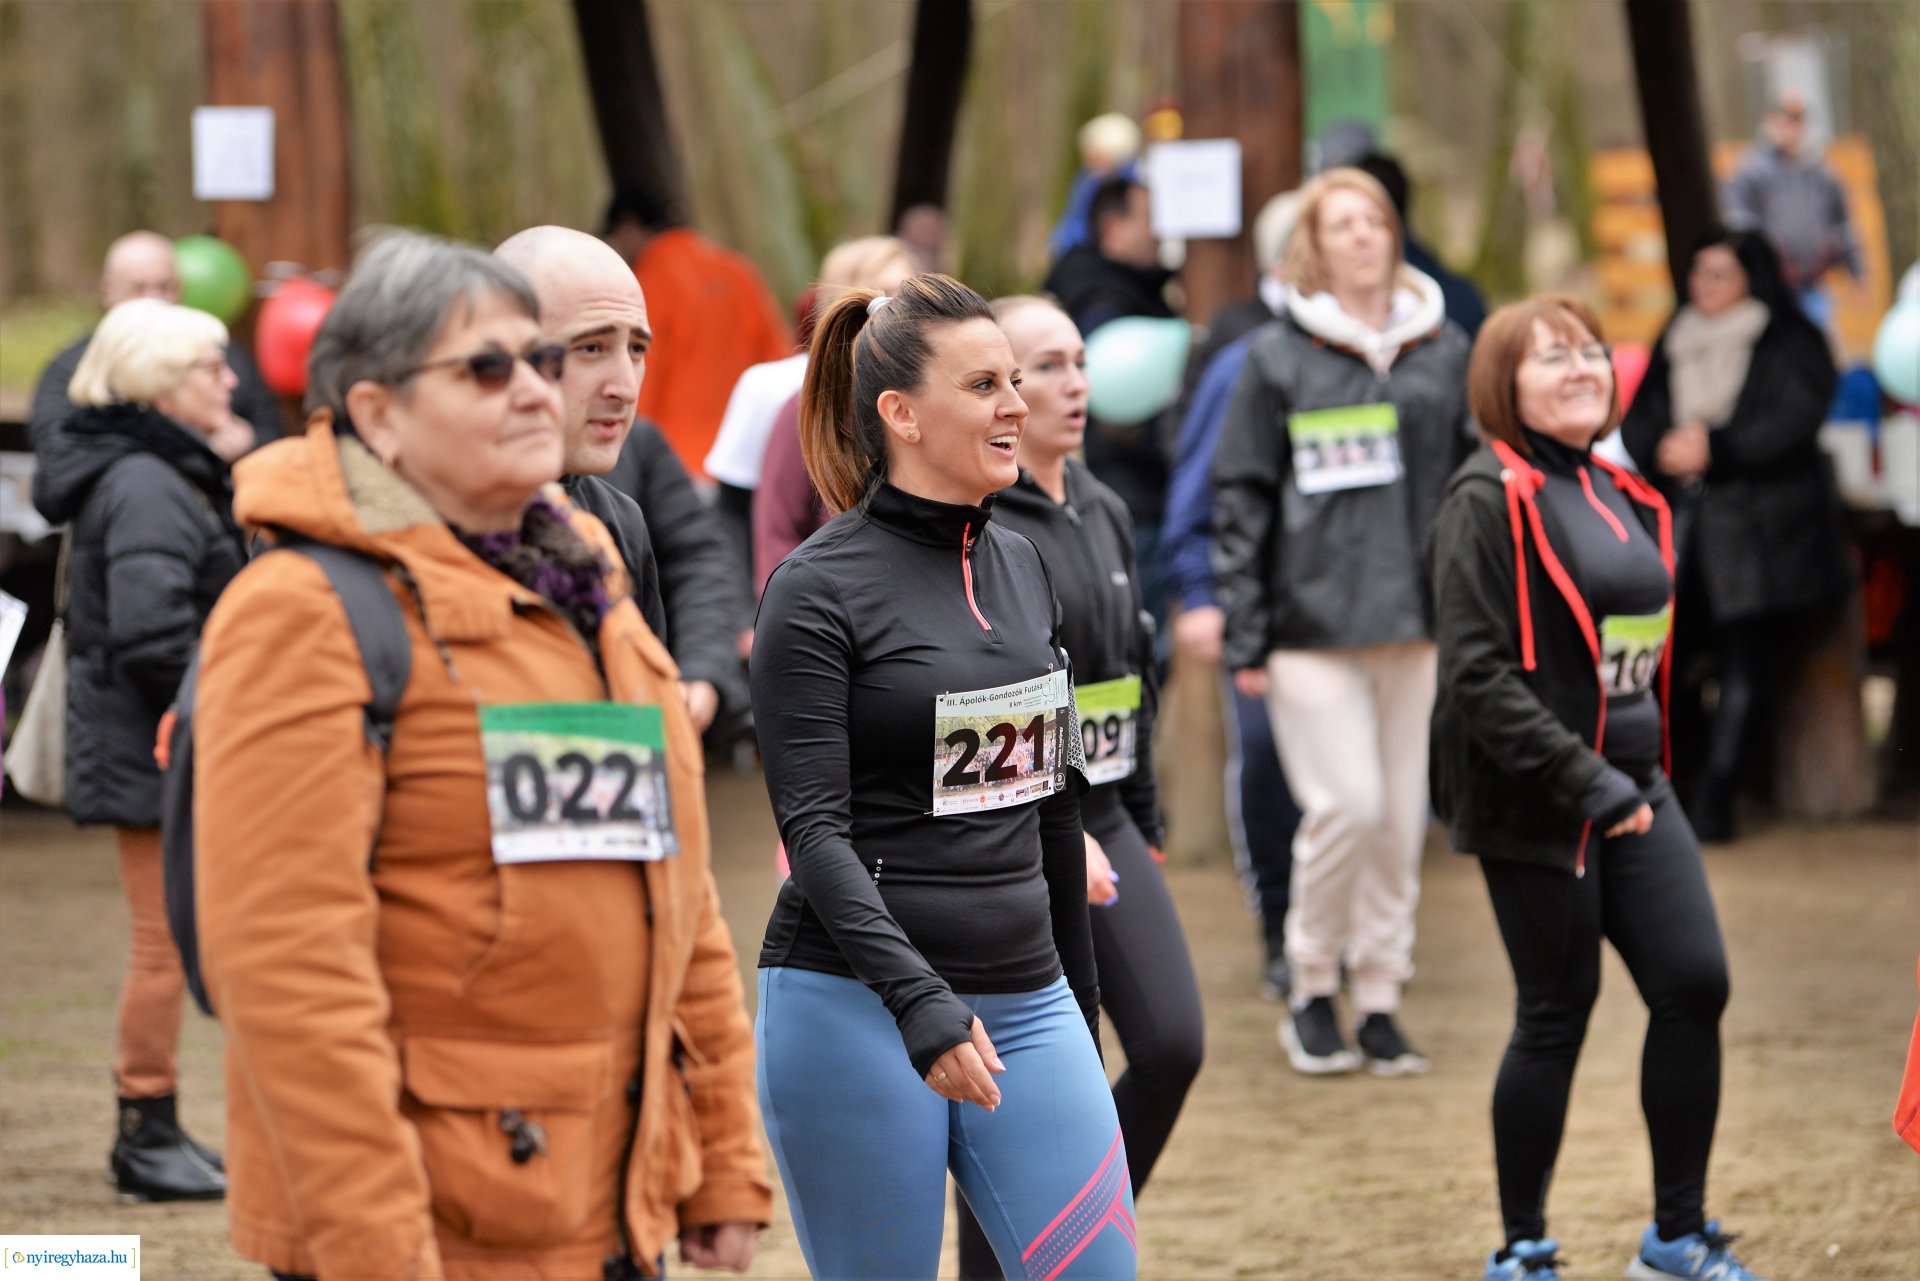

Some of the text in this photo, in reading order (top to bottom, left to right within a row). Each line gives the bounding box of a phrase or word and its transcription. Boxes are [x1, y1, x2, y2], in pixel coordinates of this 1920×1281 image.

[946, 699, 958, 707] III.
[959, 688, 1023, 707] Ápolók-Gondozók
[1024, 682, 1043, 694] Futása
[943, 713, 1045, 787] 221
[1081, 714, 1120, 760] 09
[503, 752, 641, 823] 022
